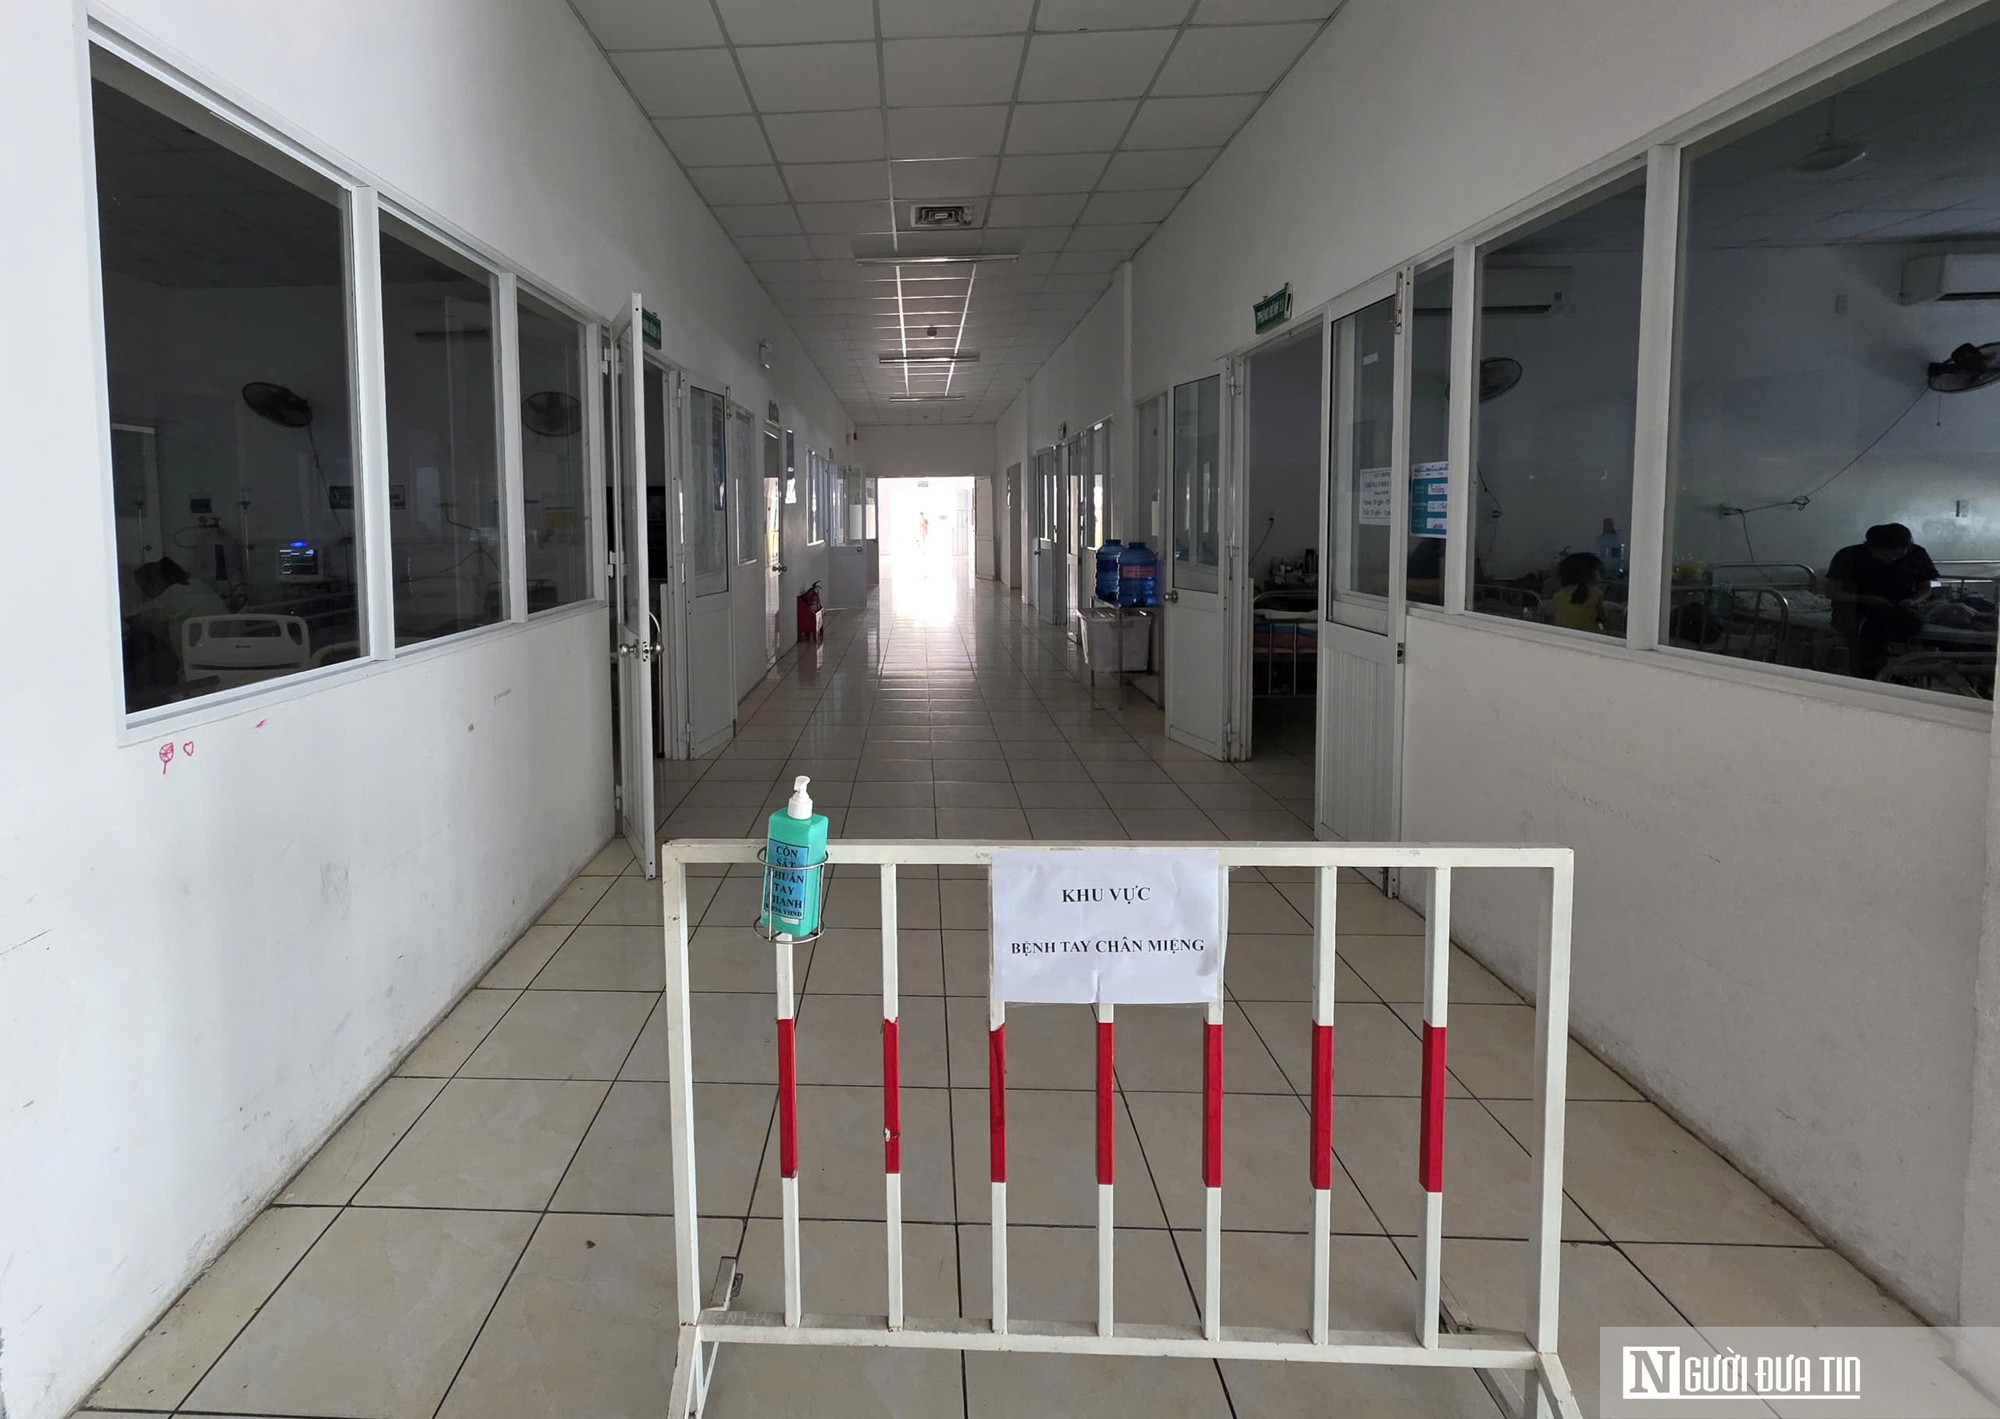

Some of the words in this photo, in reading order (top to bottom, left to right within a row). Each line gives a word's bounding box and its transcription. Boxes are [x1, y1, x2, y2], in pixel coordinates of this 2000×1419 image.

[774, 882, 795, 895] TAY
[1062, 888, 1103, 903] KHU
[1109, 885, 1151, 905] VỰC
[1011, 940, 1055, 957] BỆNH
[1060, 940, 1091, 953] TAY
[1095, 936, 1143, 954] CHÂN
